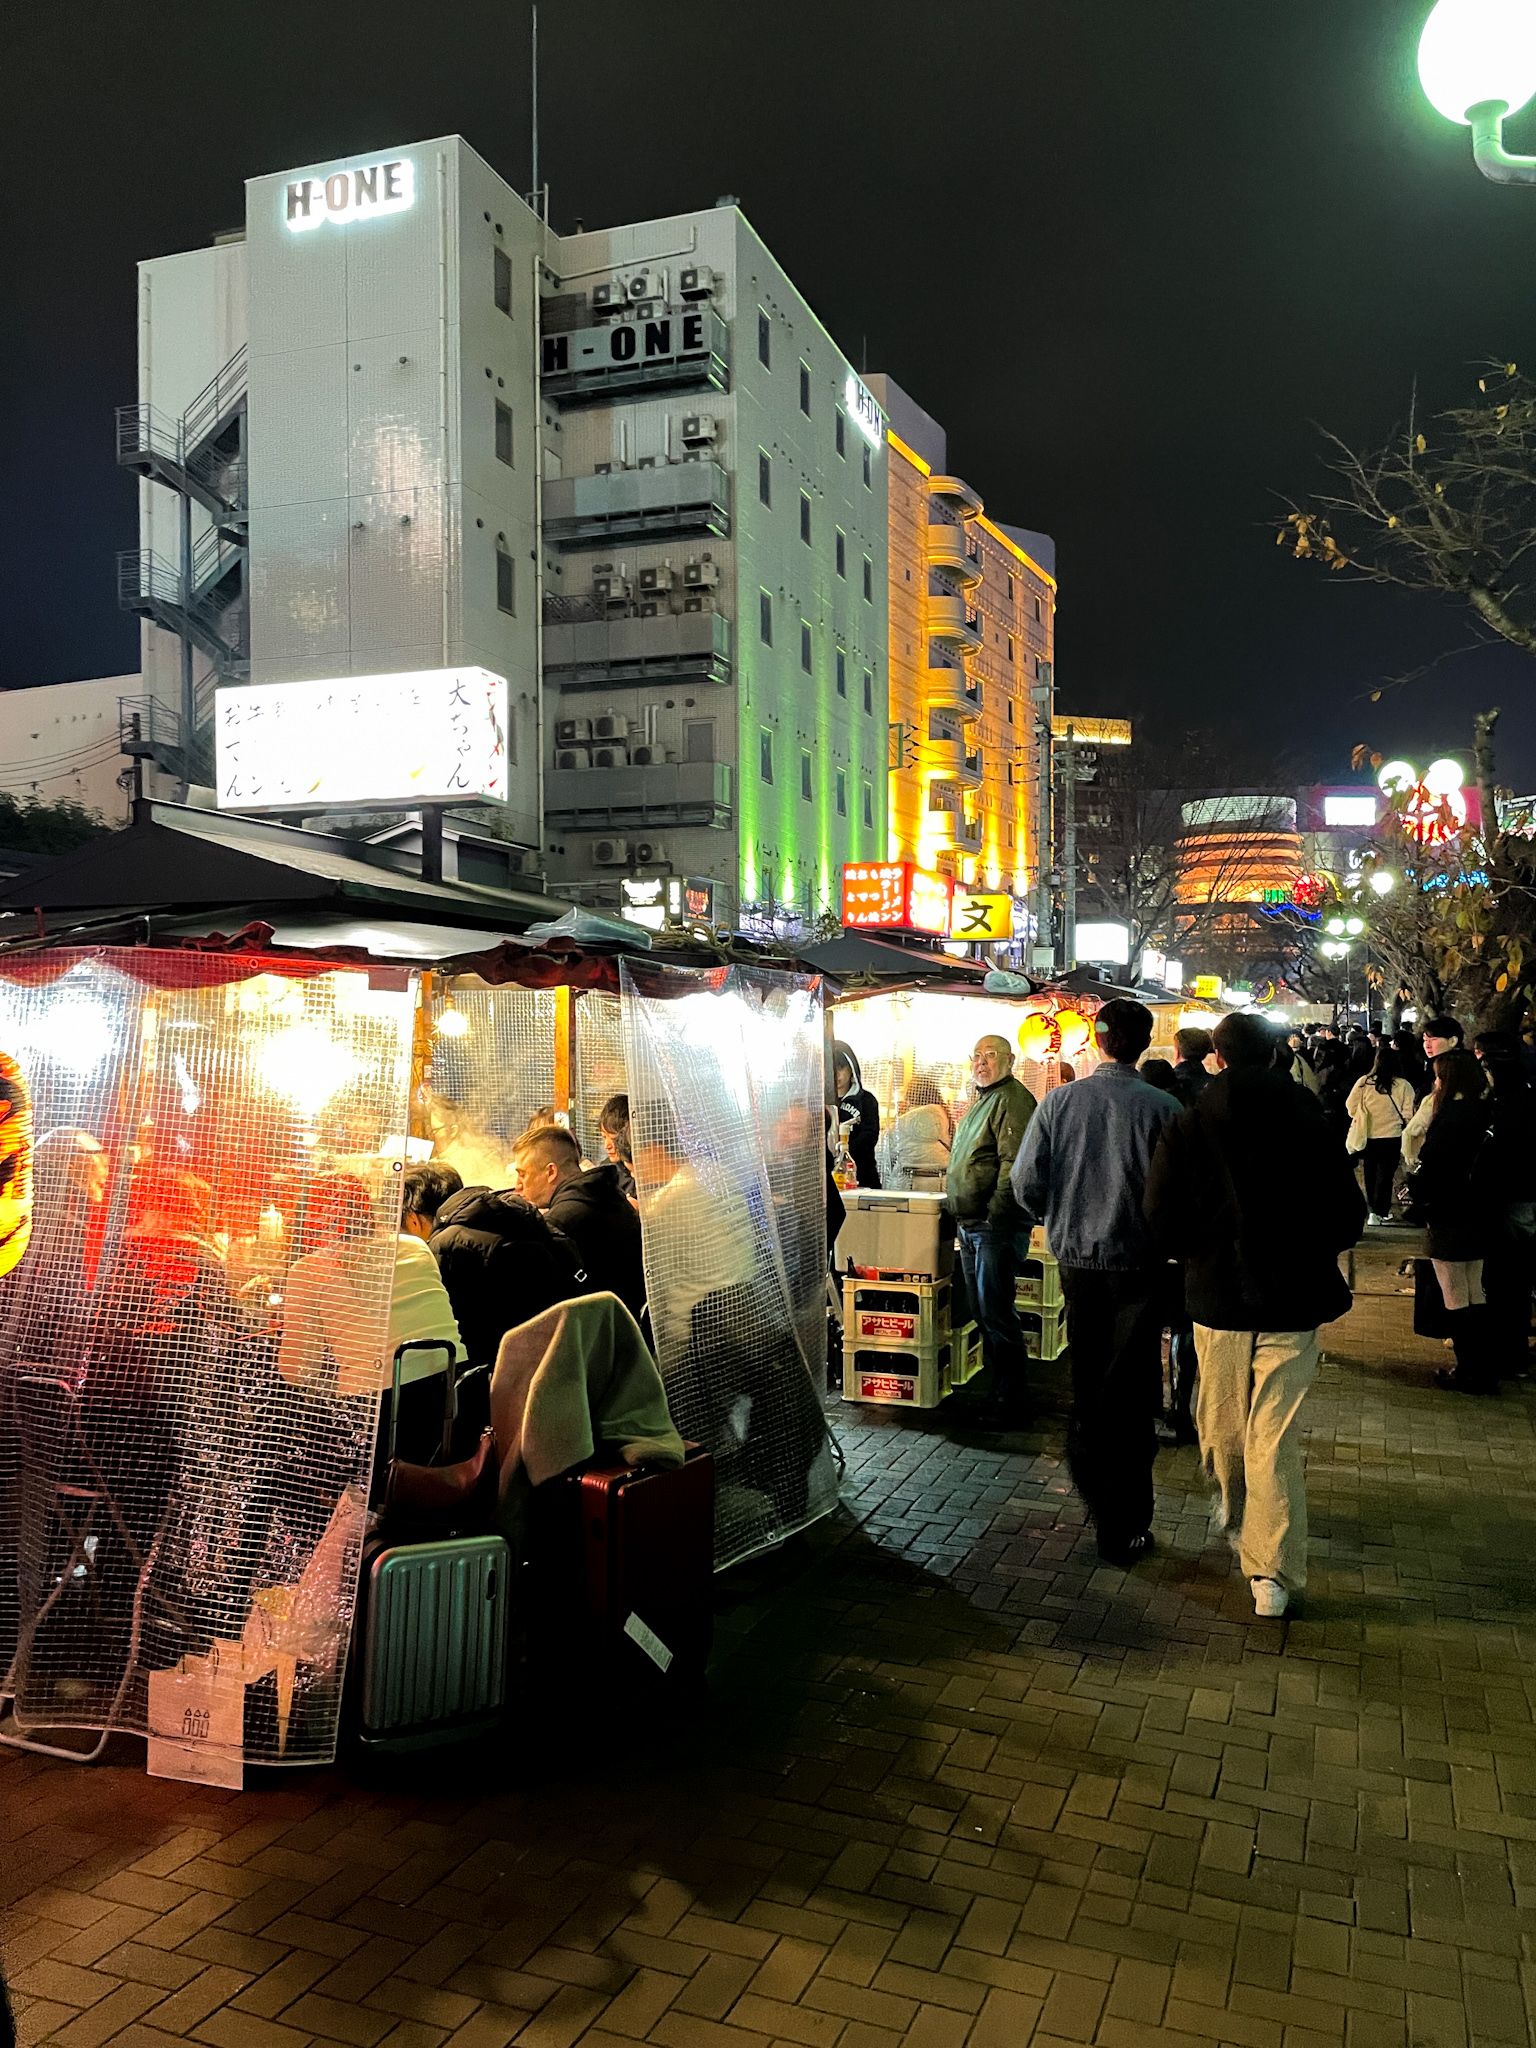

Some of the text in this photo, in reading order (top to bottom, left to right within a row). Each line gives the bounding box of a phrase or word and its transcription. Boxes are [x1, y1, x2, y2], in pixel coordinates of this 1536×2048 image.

[287, 162, 403, 220] H-ONE
[543, 315, 703, 373] H-ONE
[961, 901, 993, 932] 文
[863, 1316, 913, 1329] アサヒビール
[863, 1377, 913, 1391] アサヒビール
